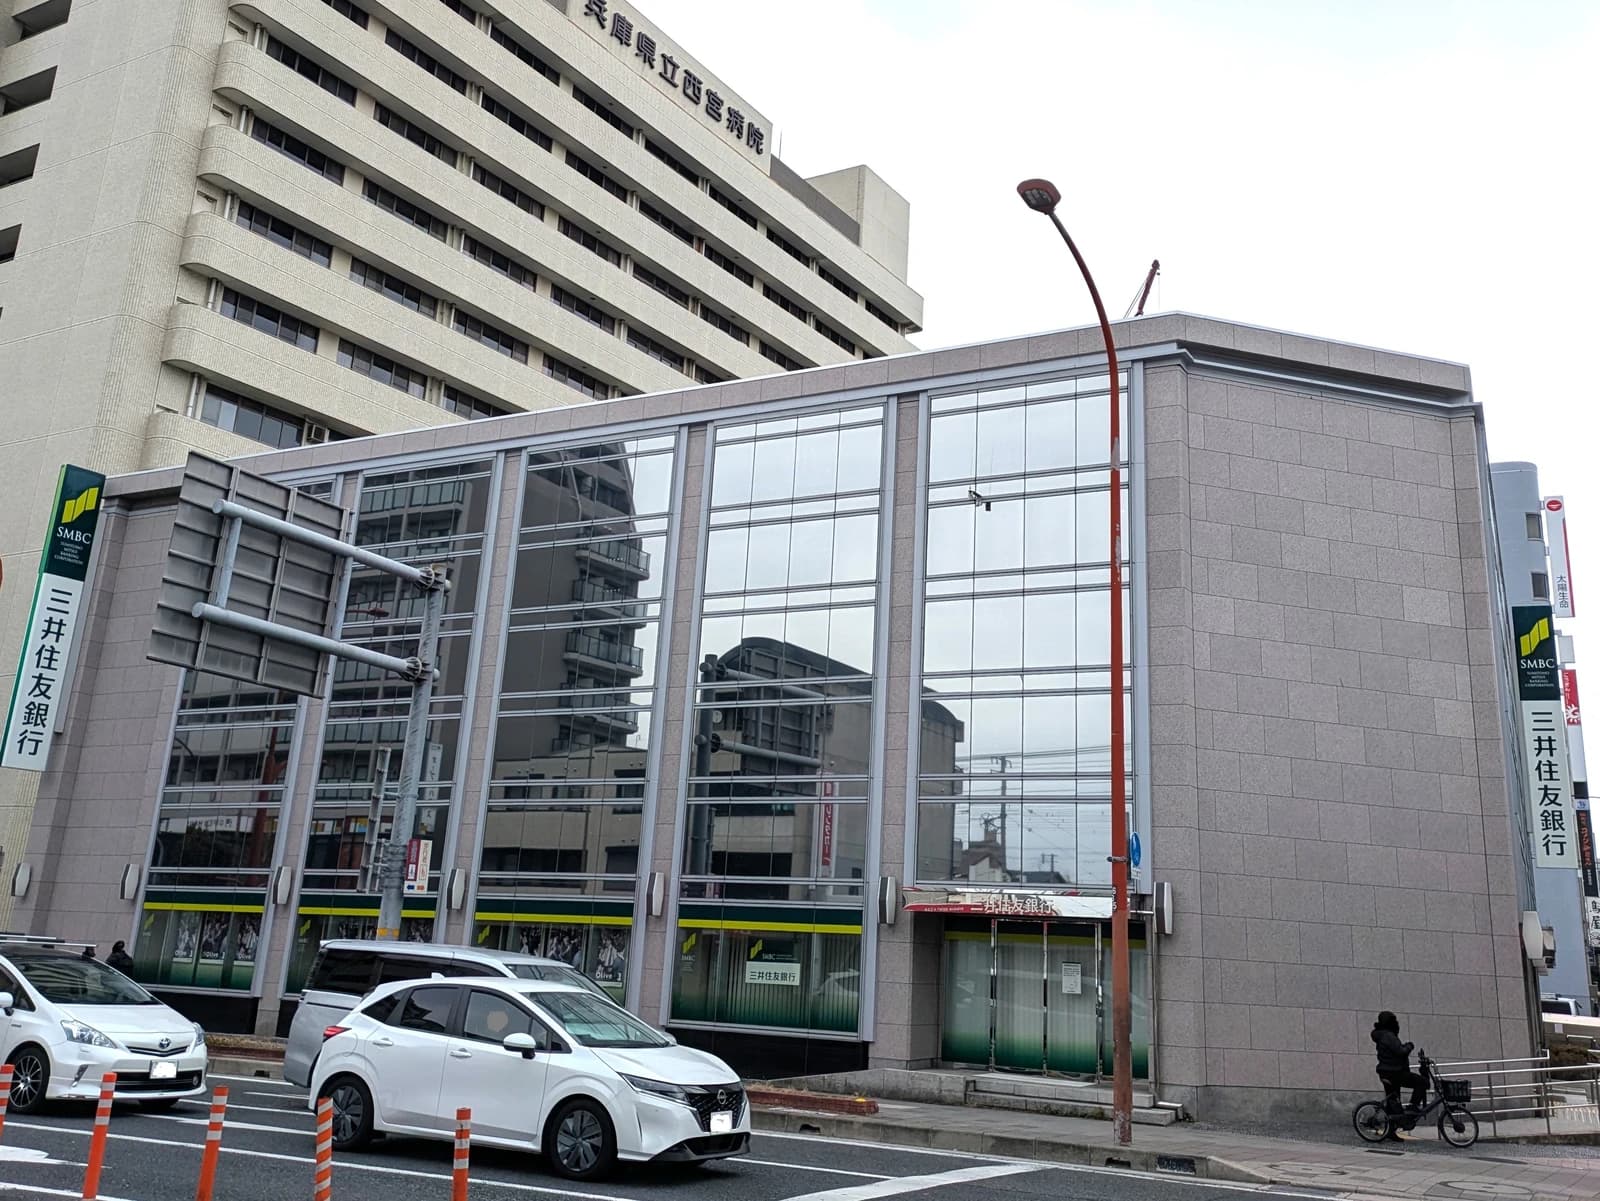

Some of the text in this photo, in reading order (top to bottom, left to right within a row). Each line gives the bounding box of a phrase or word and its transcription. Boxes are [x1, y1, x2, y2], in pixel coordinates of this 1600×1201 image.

[584, 0, 764, 155] 兵庫県立西宮病院
[56, 526, 92, 544] SMBC
[16, 588, 73, 757] 三井住友銀行
[1520, 658, 1555, 669] SMBC
[1531, 711, 1567, 856] 三井住友銀行
[749, 970, 797, 982] 三井住友銀行
